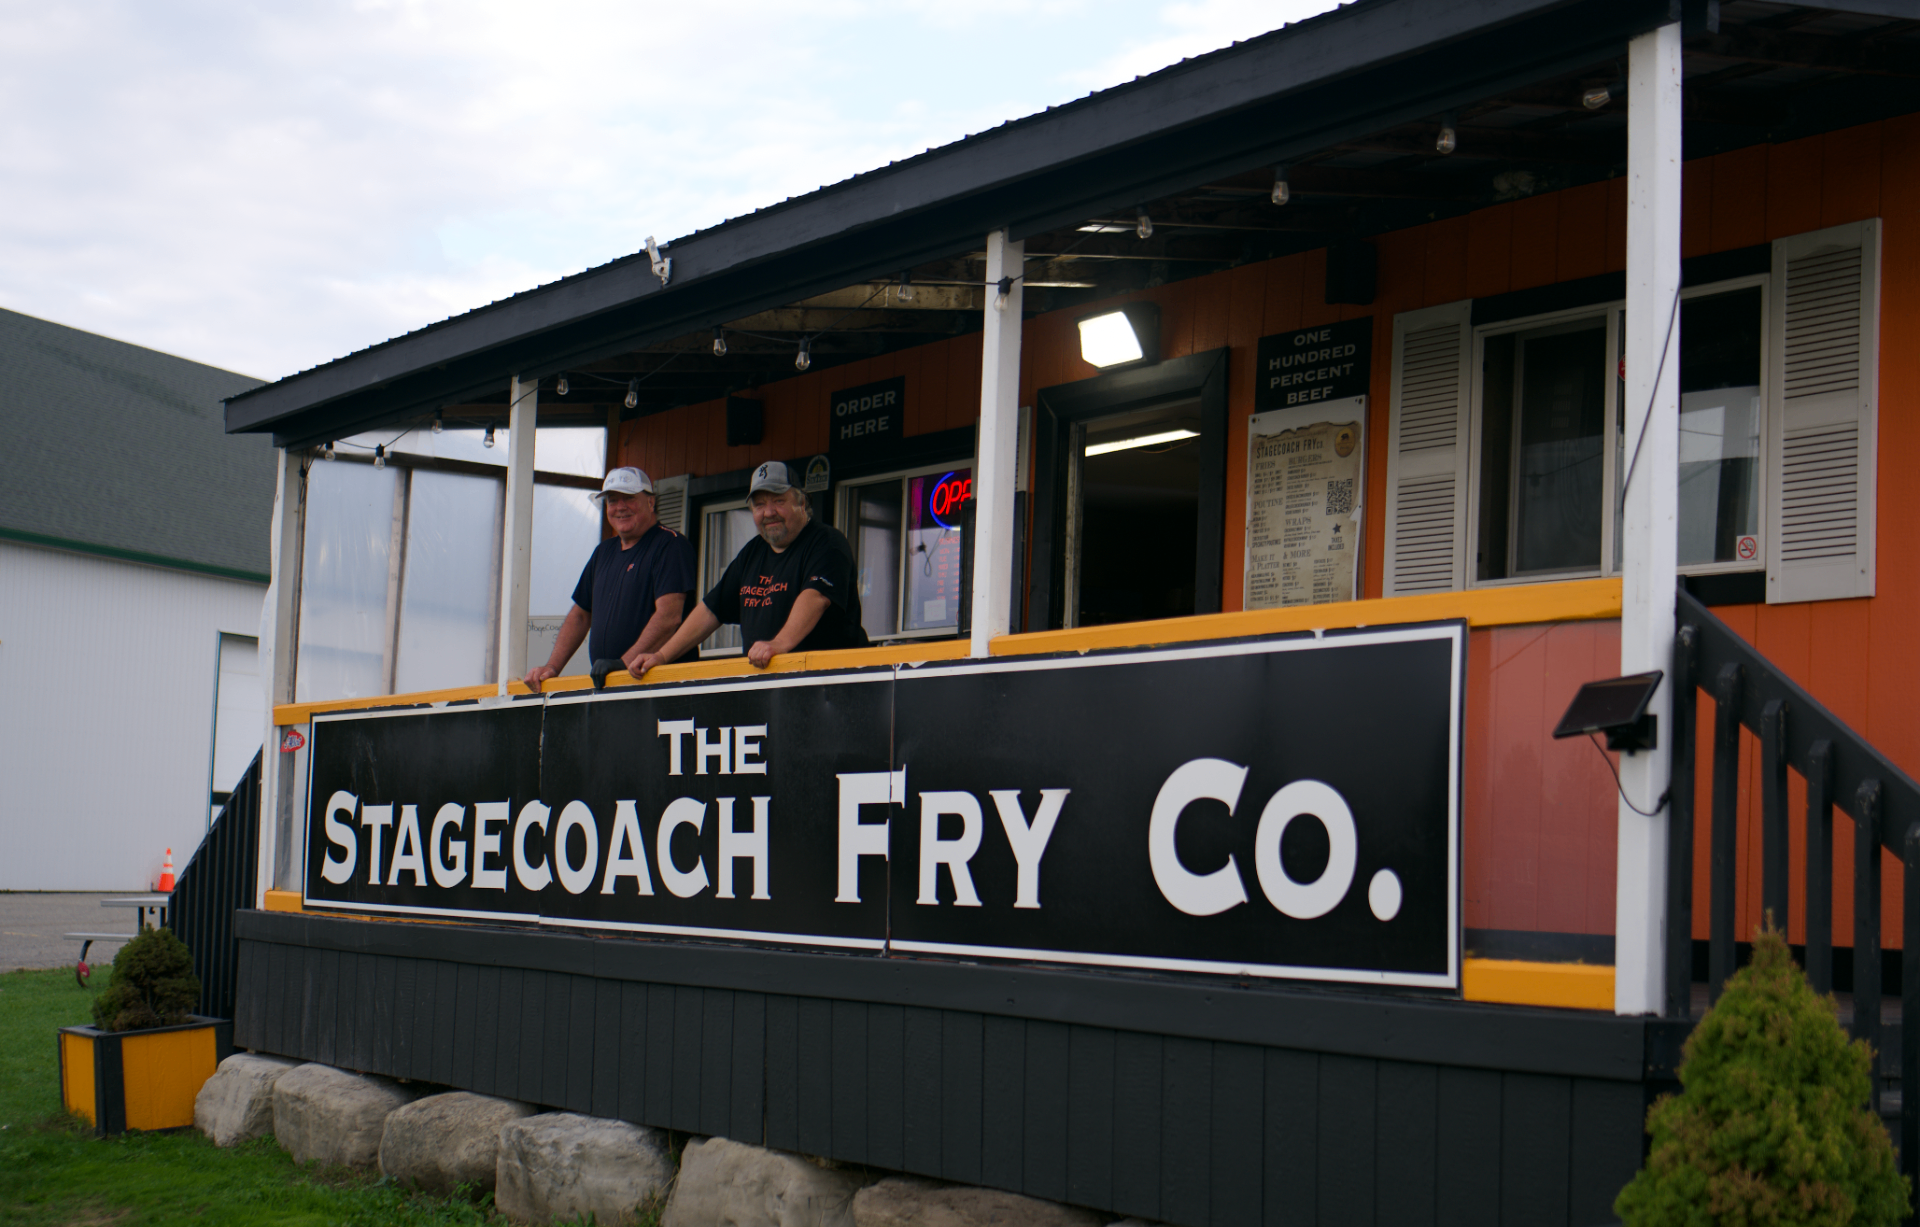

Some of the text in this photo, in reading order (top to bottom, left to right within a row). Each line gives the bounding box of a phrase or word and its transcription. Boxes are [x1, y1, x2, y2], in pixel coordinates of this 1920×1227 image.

[1294, 329, 1331, 346] ONE
[1269, 344, 1356, 371] HUNDRED
[1270, 363, 1354, 389] PERCENT
[836, 390, 896, 417] ORDER
[1287, 386, 1333, 405] BEEF
[841, 416, 889, 440] HERE
[1257, 440, 1300, 459] STAGECOACH
[1303, 438, 1316, 452] FRY
[932, 479, 972, 515] OPE
[1253, 497, 1284, 510] POUTINE
[1285, 516, 1312, 527] WRAPS
[1290, 549, 1312, 559] MORE
[744, 597, 761, 608] FRY
[657, 717, 768, 775] THE
[321, 758, 1402, 921] STAGECOACH FRY CO.
